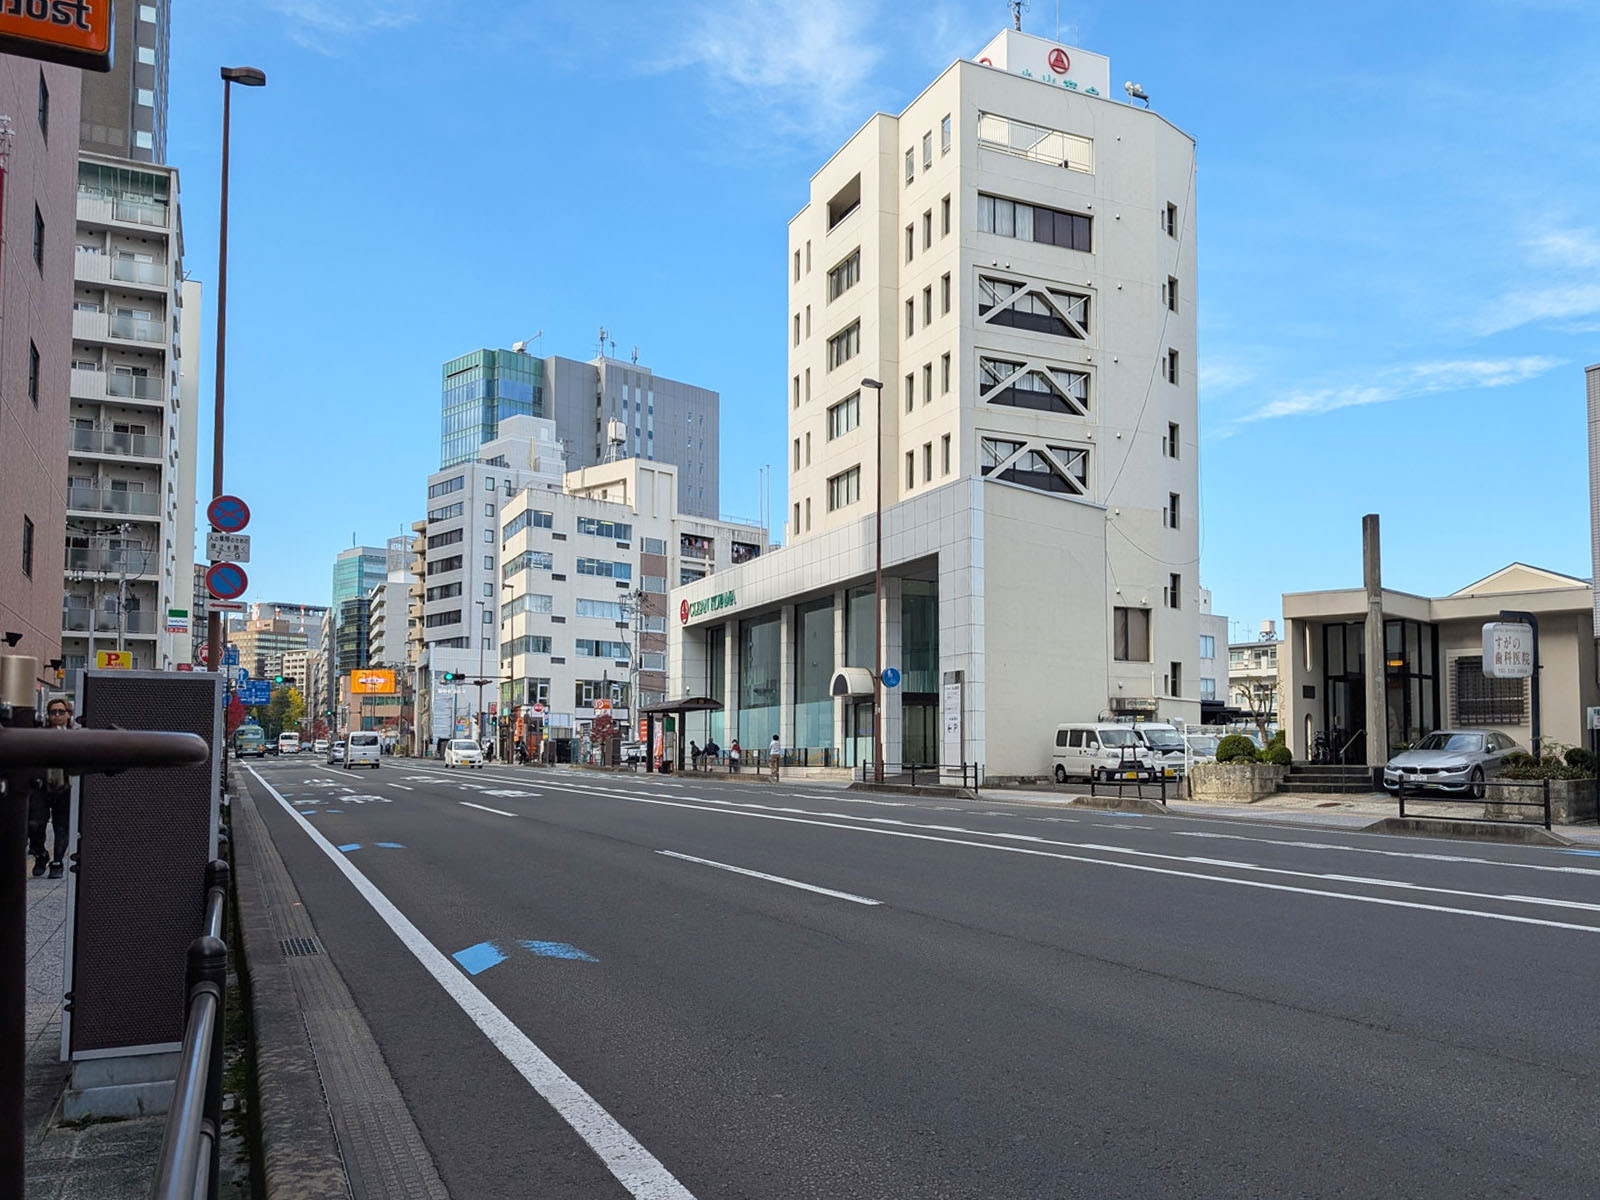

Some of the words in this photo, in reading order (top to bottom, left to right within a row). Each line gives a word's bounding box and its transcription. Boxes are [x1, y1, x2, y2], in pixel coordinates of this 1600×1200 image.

[1495, 635, 1521, 650] すがの
[105, 652, 121, 666] P
[1495, 651, 1531, 666] 歯科医院
